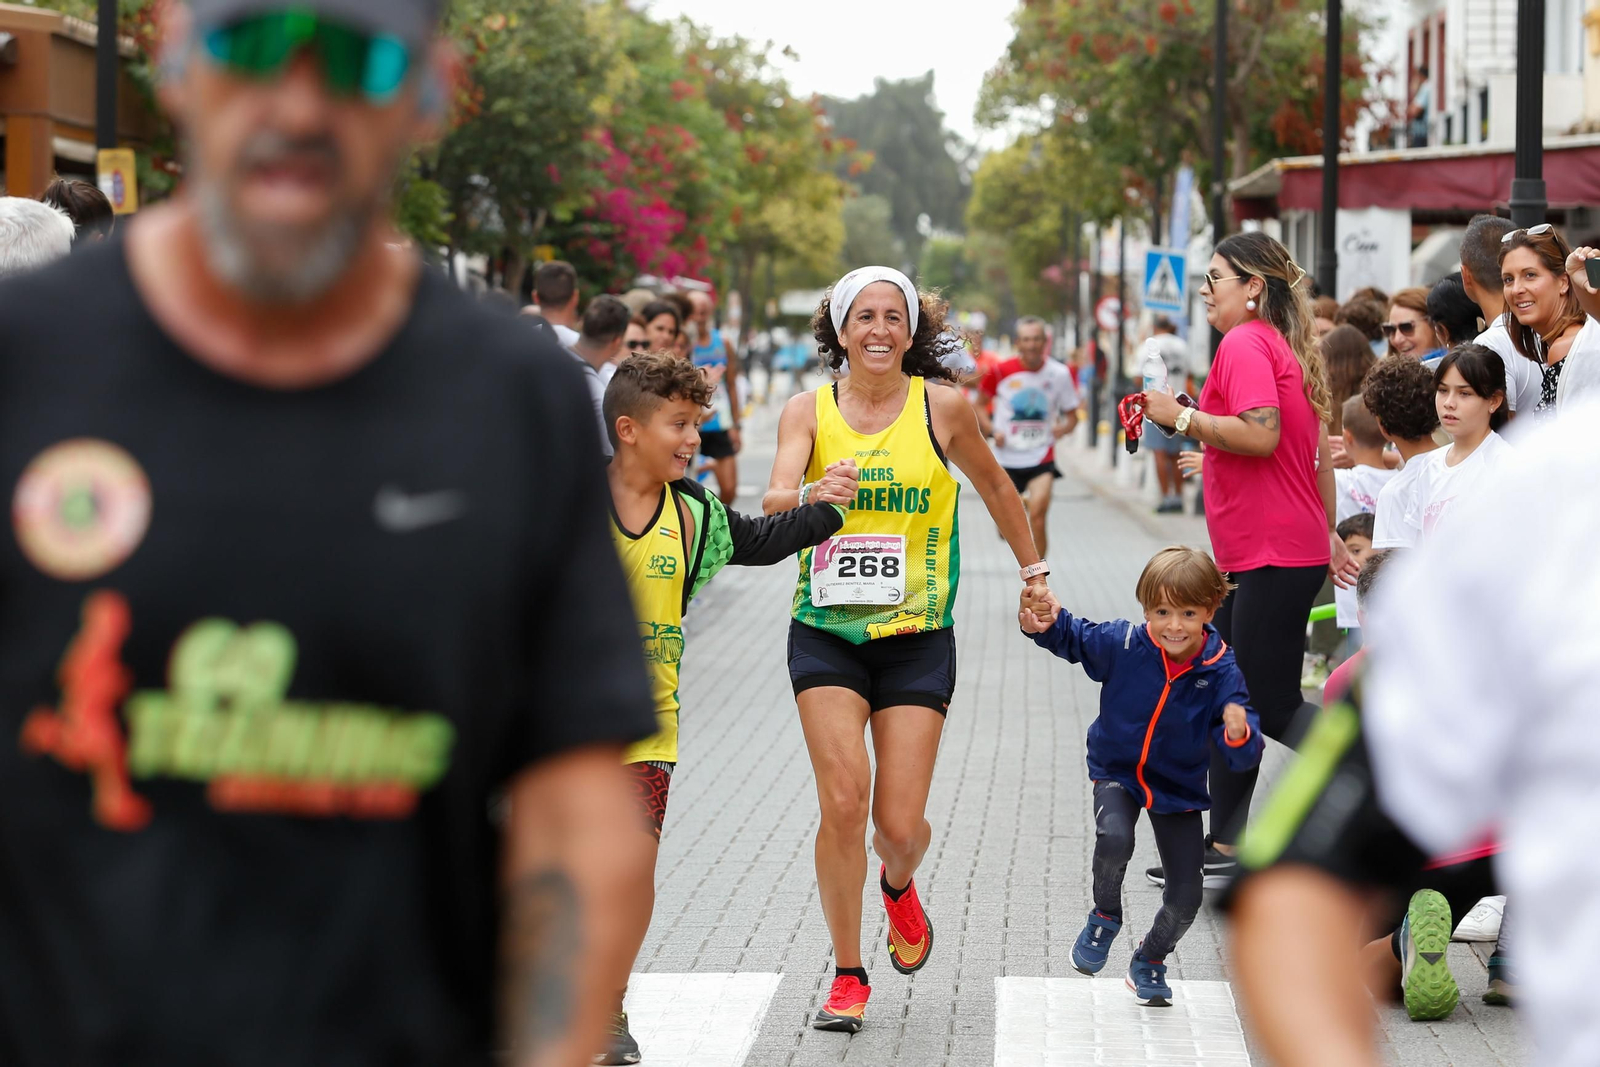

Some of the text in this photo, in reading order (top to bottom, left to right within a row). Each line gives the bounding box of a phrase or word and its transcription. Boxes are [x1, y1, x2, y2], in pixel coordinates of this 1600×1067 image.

[857, 467, 894, 481] NERS
[849, 482, 931, 514] REÑOS
[926, 527, 940, 556] VILLA
[838, 556, 899, 577] 268
[925, 558, 936, 572] DE
[926, 574, 938, 592] LOS
